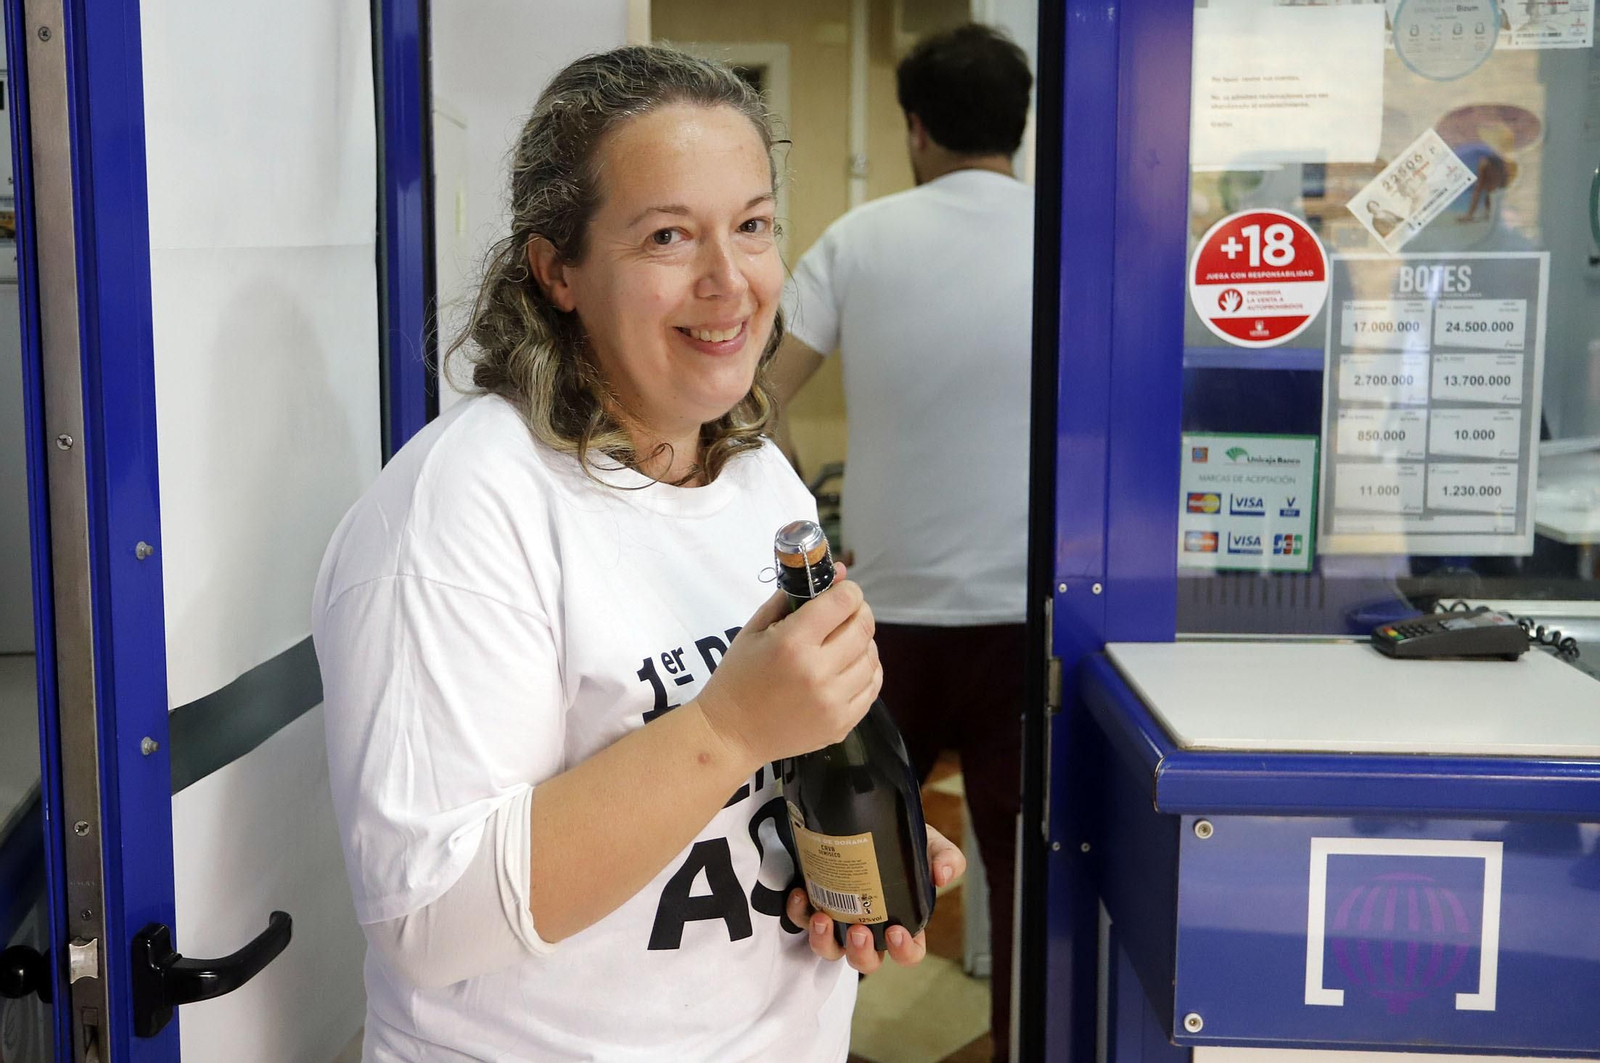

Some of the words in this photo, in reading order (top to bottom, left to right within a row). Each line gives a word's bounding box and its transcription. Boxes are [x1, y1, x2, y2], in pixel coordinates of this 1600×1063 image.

[1220, 223, 1296, 268] +18
[1206, 272, 1229, 281] JUEGA
[1230, 272, 1247, 280] CON
[1248, 269, 1315, 280] RESPONSABILIDAD
[1399, 265, 1473, 293] BOTES
[1353, 321, 1420, 333] 17.000.000
[1445, 321, 1514, 333] 24.500.000
[1354, 374, 1414, 386] 2.700.000
[1444, 375, 1511, 387] 13.700.000
[1357, 429, 1406, 441] 850.000
[1454, 429, 1496, 441] 10.000
[1199, 475, 1231, 483] MARCAS
[1233, 475, 1243, 483] DE
[1359, 485, 1400, 496] 11.000
[1442, 485, 1502, 497] 1.230.000
[1236, 497, 1264, 508] VISA
[1233, 534, 1262, 546] VISA
